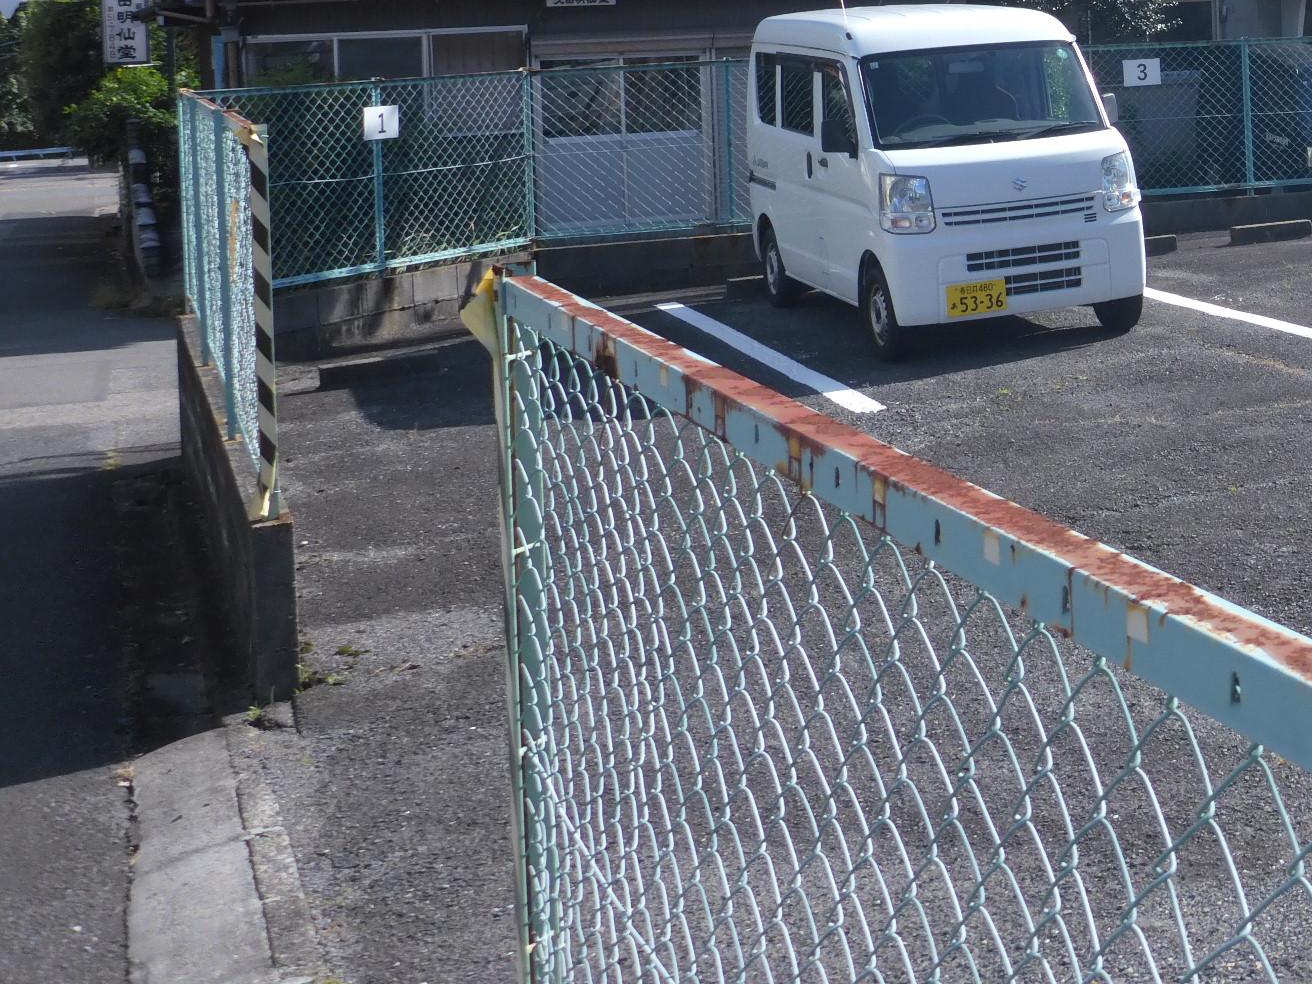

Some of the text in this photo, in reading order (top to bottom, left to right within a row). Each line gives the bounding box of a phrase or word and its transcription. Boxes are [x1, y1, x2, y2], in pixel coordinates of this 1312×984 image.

[1137, 63, 1148, 81] 3
[378, 113, 387, 134] 1
[960, 291, 1004, 313] 53-36
